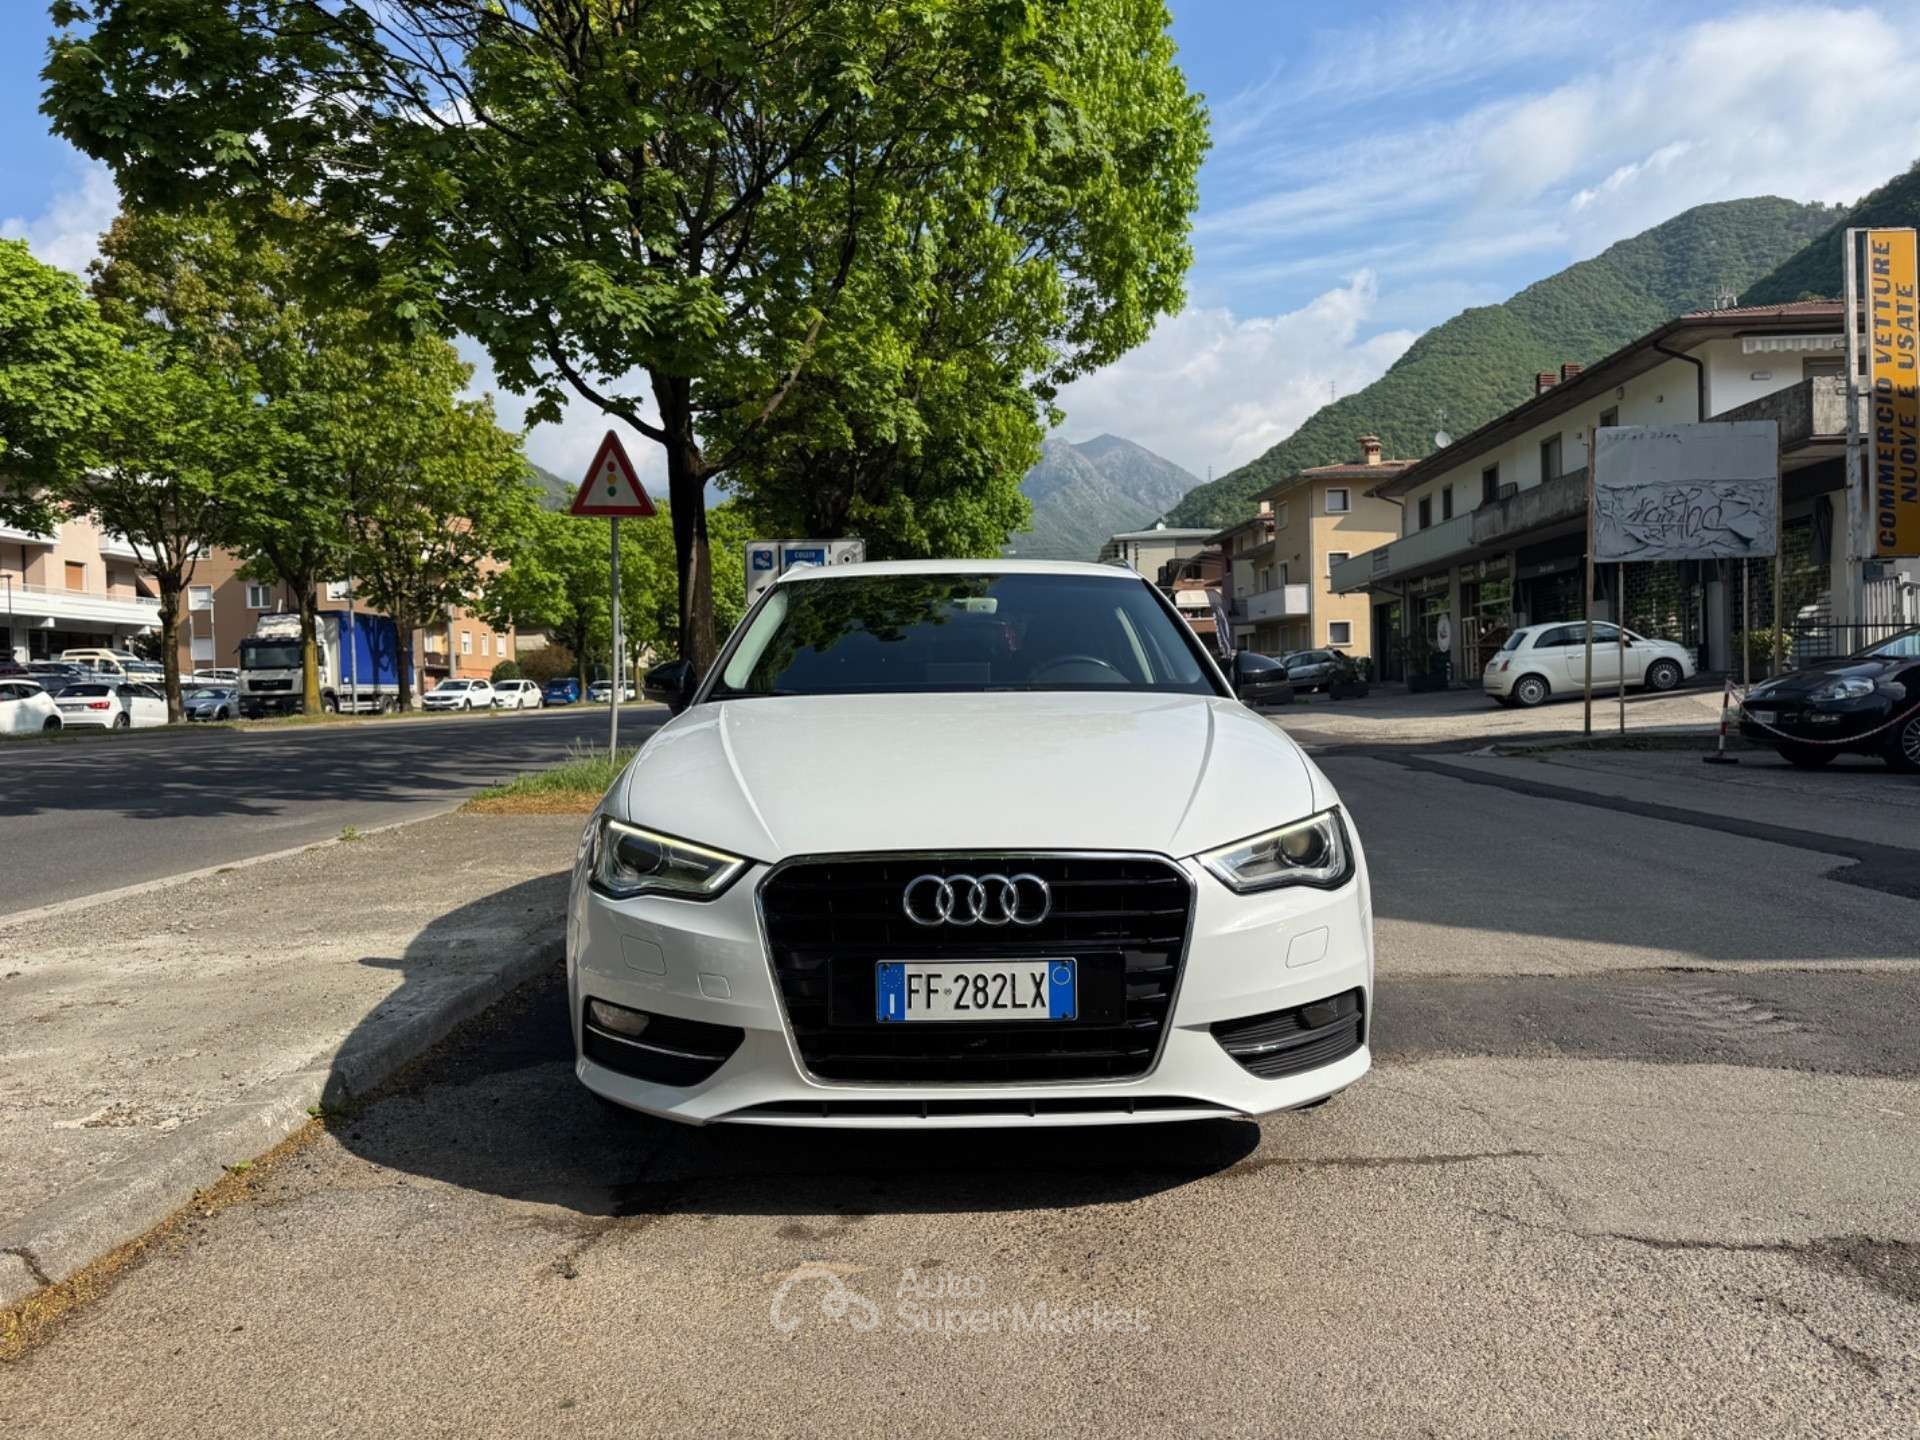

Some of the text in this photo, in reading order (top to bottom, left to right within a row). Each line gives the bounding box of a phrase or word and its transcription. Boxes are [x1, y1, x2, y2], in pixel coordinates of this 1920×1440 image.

[1871, 239, 1896, 549] COMMERCIO VETTURE
[1896, 282, 1917, 504] NUOVE E USATE
